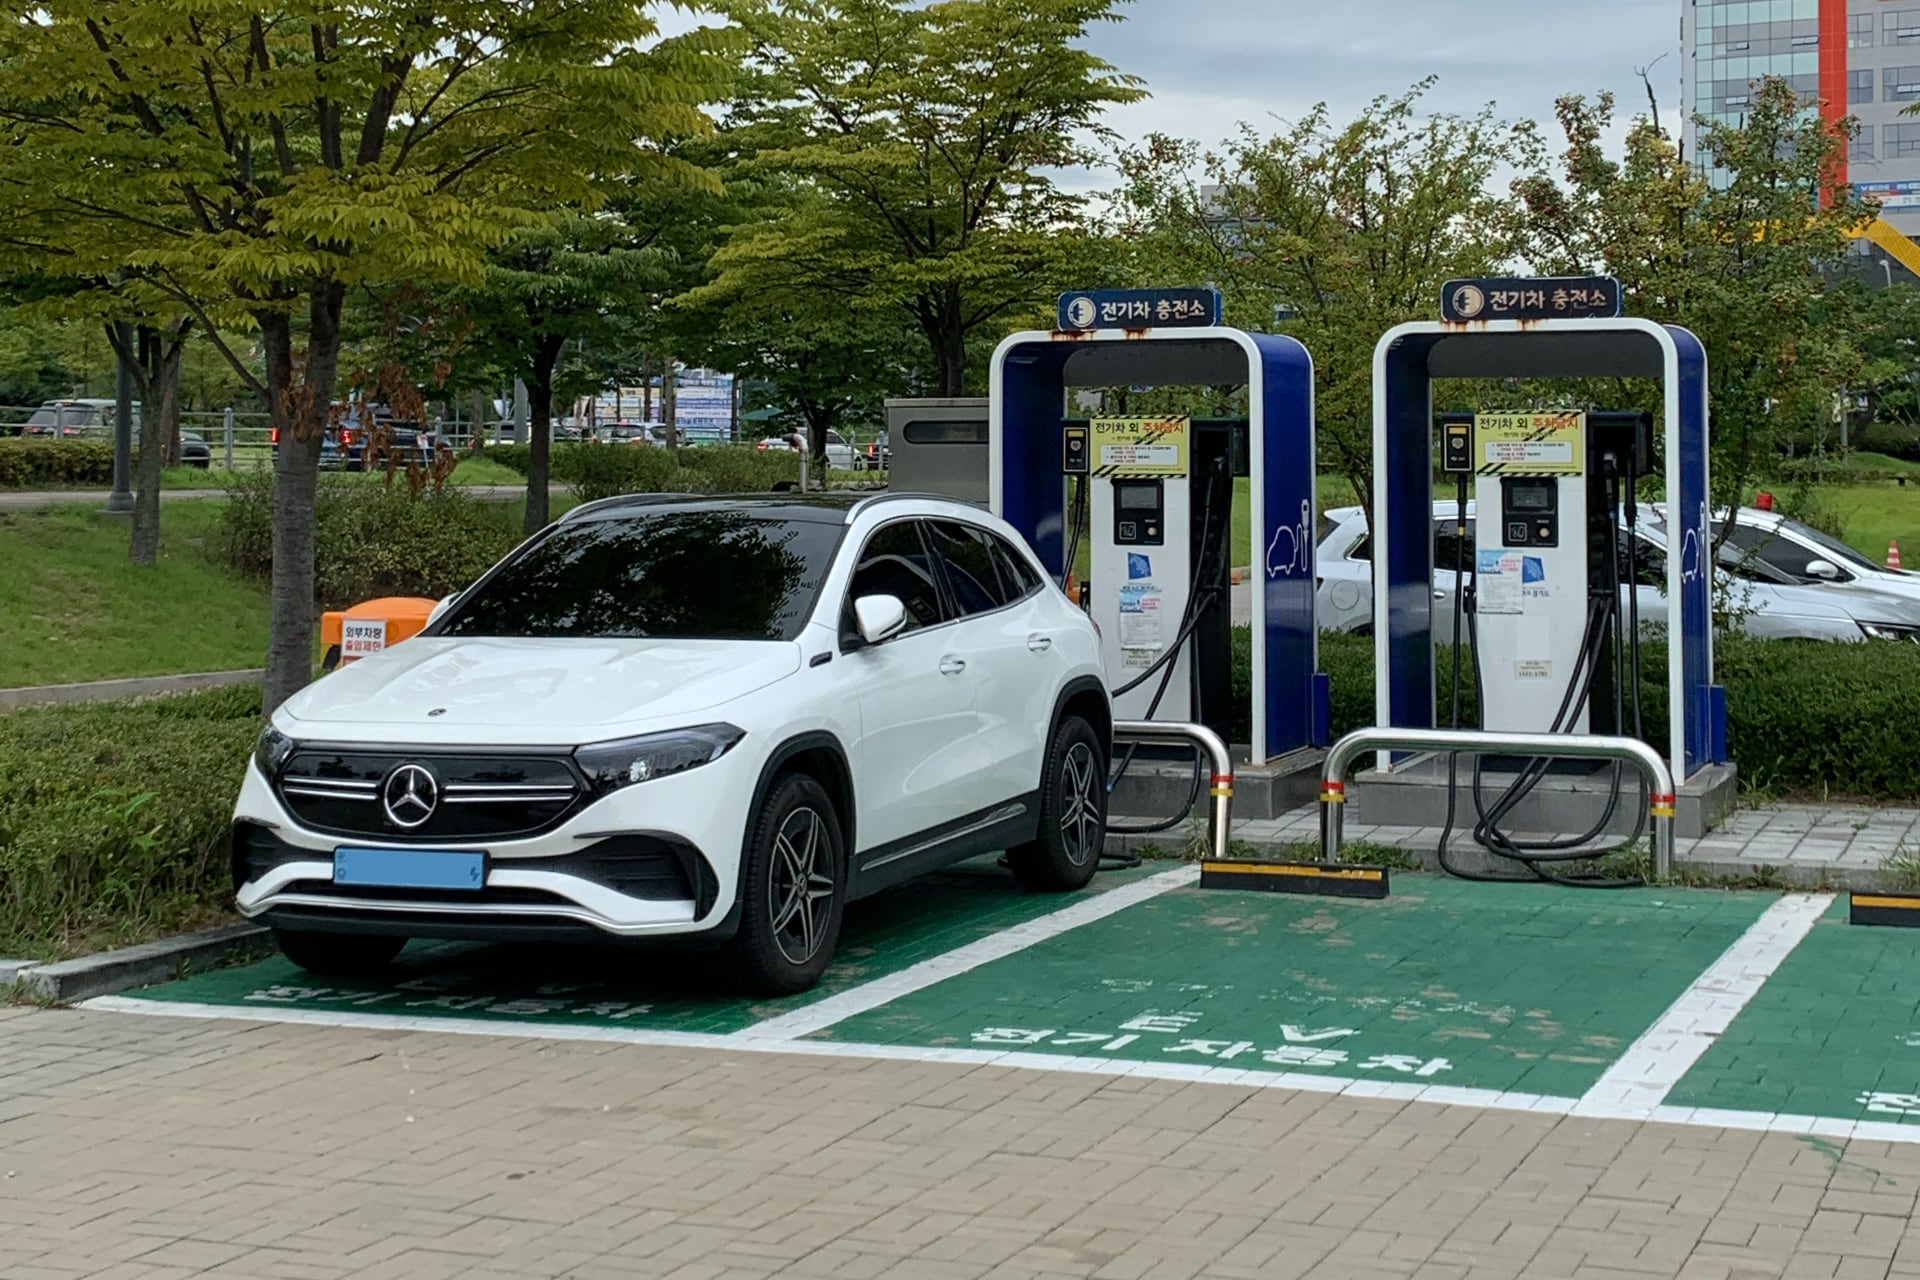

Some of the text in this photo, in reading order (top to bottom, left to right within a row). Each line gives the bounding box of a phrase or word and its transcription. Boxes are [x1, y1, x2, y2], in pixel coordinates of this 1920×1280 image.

[1490, 288, 1608, 311] 전기차 충전소
[1100, 299, 1206, 322] 전기차 충전소
[1095, 422, 1126, 434] 전기차
[1128, 422, 1139, 433] 외
[1480, 417, 1512, 430] 전기차
[1516, 417, 1528, 429] 외
[345, 626, 383, 638] 외부차량
[345, 640, 382, 652] 출입제한
[243, 985, 655, 1019] 전기자동차
[970, 1026, 1454, 1077] 전기자동차
